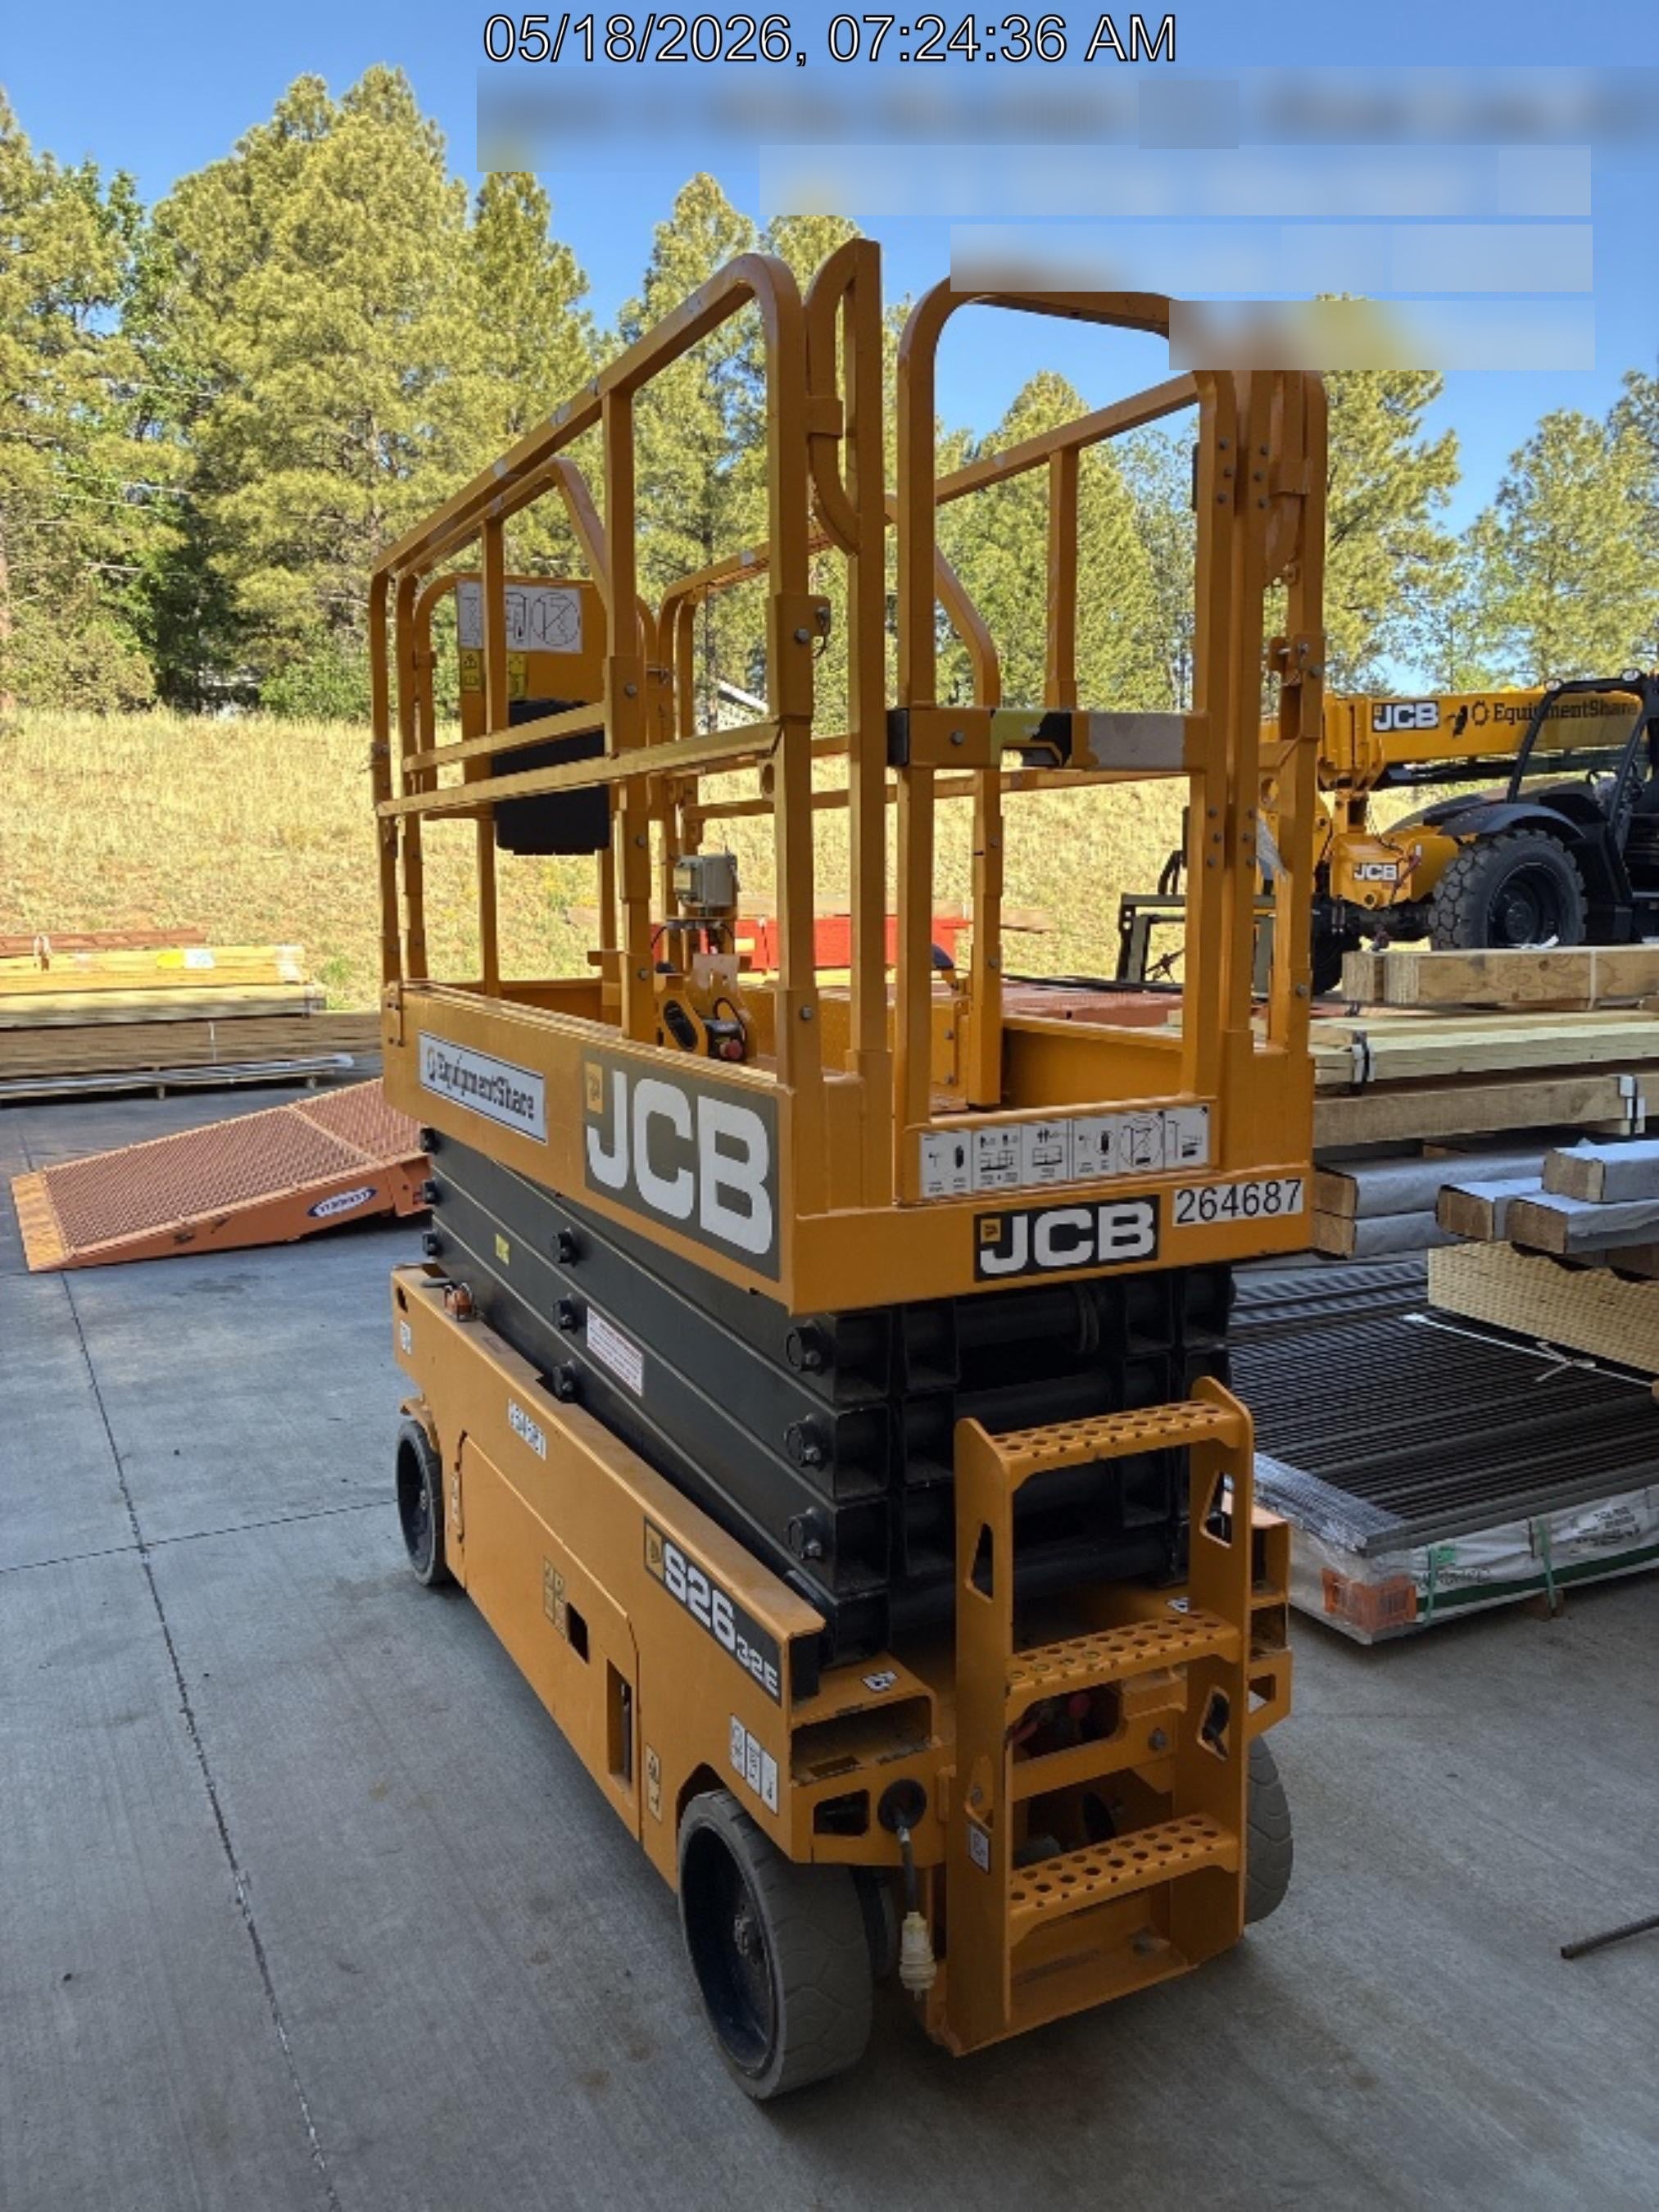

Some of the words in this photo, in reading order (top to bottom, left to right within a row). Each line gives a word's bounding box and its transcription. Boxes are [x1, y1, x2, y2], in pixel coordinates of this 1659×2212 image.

[1373, 702, 1439, 731] JCB
[1353, 863, 1398, 882] JCB
[587, 1069, 773, 1255] JCB
[1176, 1178, 1303, 1225] 264687
[979, 1201, 1156, 1275] JCB
